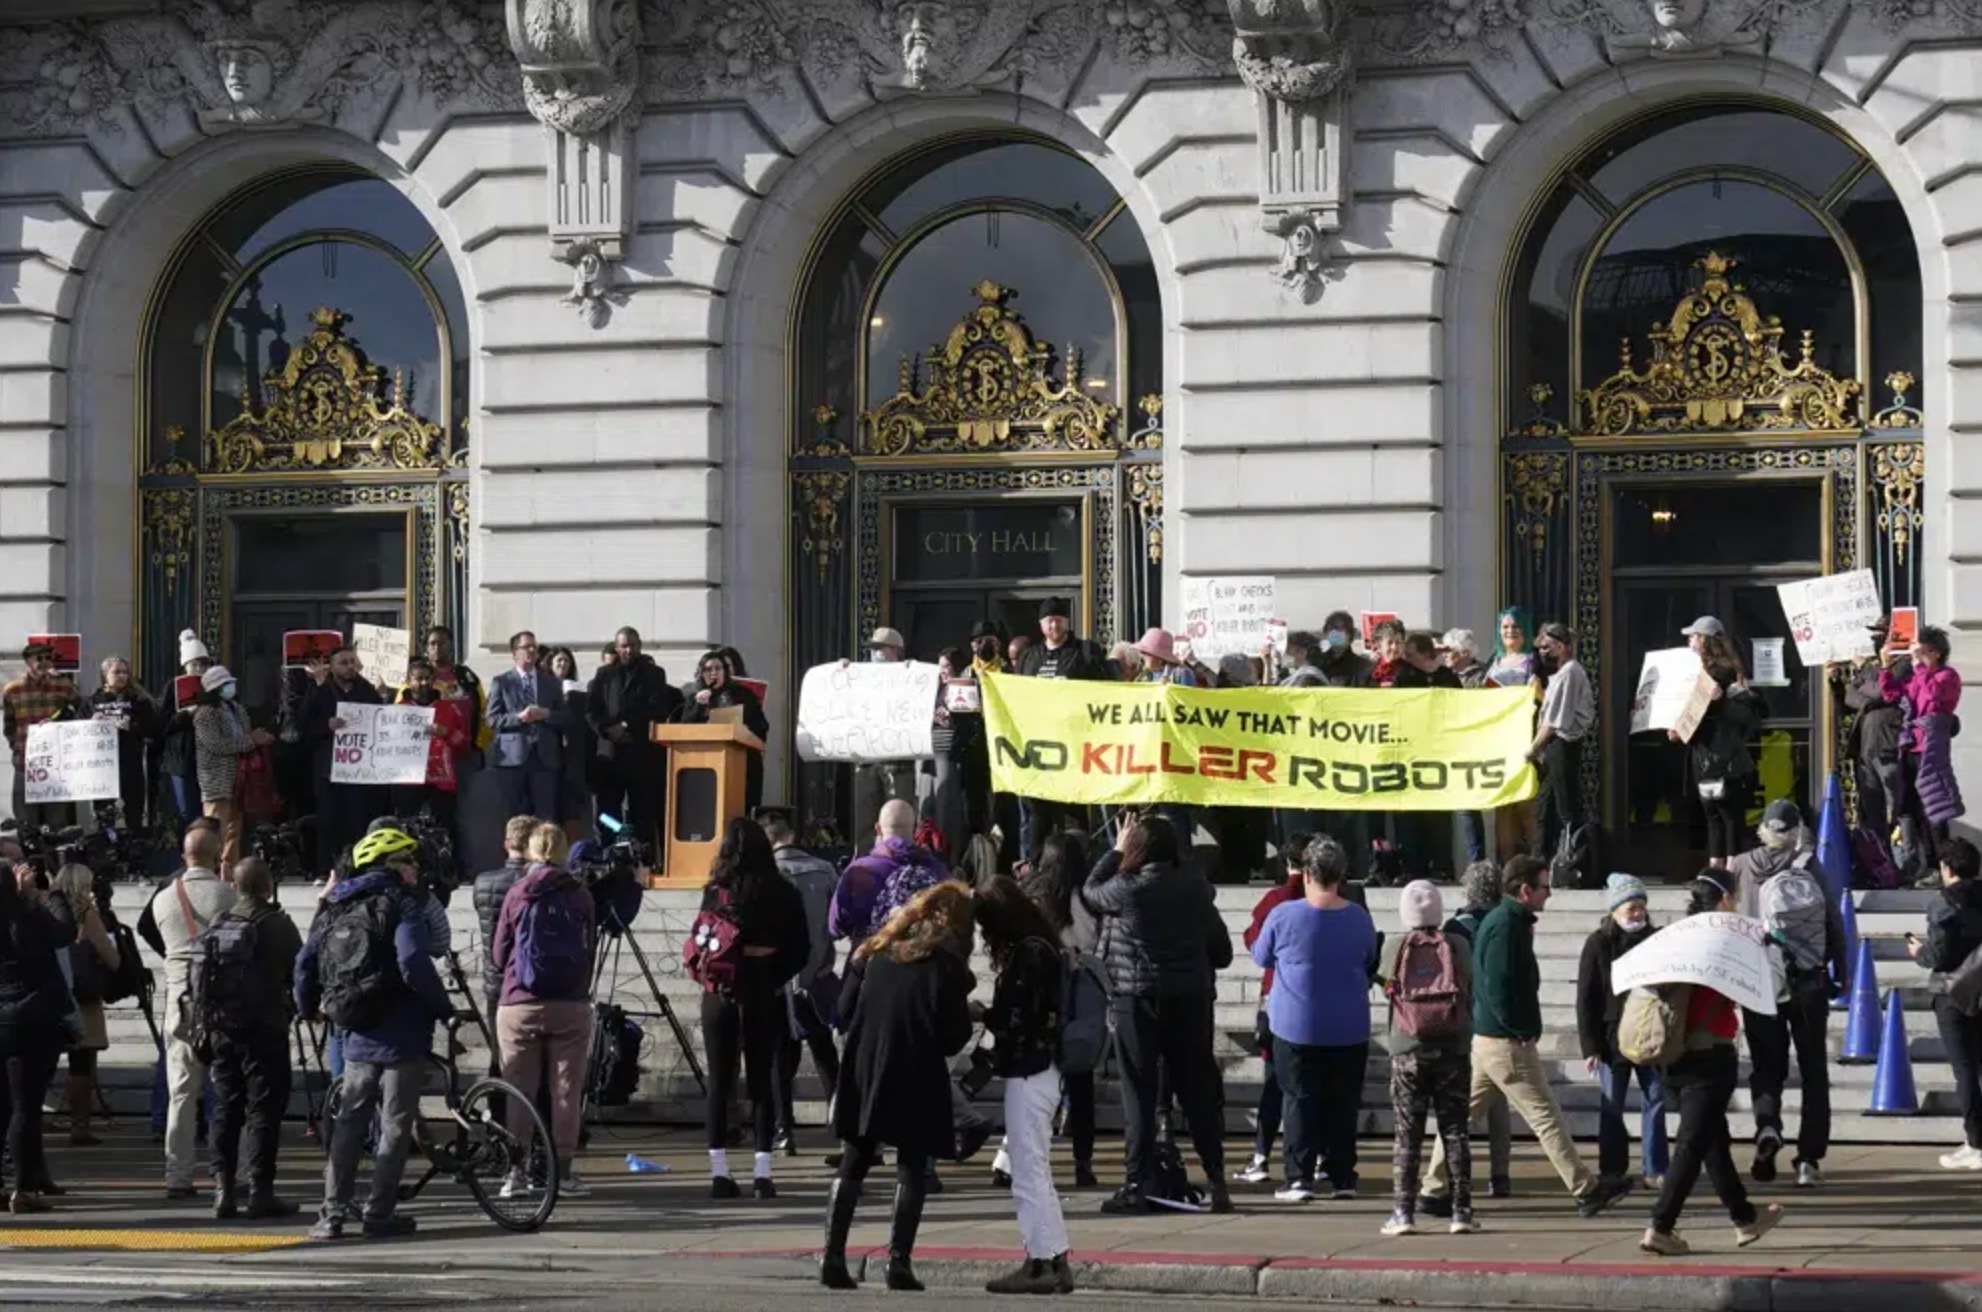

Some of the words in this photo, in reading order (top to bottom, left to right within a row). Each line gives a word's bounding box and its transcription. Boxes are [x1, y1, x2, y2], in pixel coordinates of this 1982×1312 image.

[924, 531, 982, 553] CITY
[991, 530, 1058, 553] HALL
[1186, 621, 1207, 639] NO
[1793, 626, 1814, 643] NO
[374, 653, 390, 668] NO
[1087, 703, 1122, 725] WE
[1129, 701, 1166, 722] ALL
[1174, 704, 1231, 730] SAW
[1237, 711, 1301, 735] THAT
[1309, 717, 1408, 745] MOVIE...
[335, 733, 368, 749] VOTE
[335, 747, 362, 764] NO
[994, 735, 1068, 771] NO
[1080, 741, 1277, 784] KILLER
[1288, 754, 1506, 795] ROBOTS
[26, 768, 49, 784] NO
[1709, 915, 1766, 947] CHECKS
